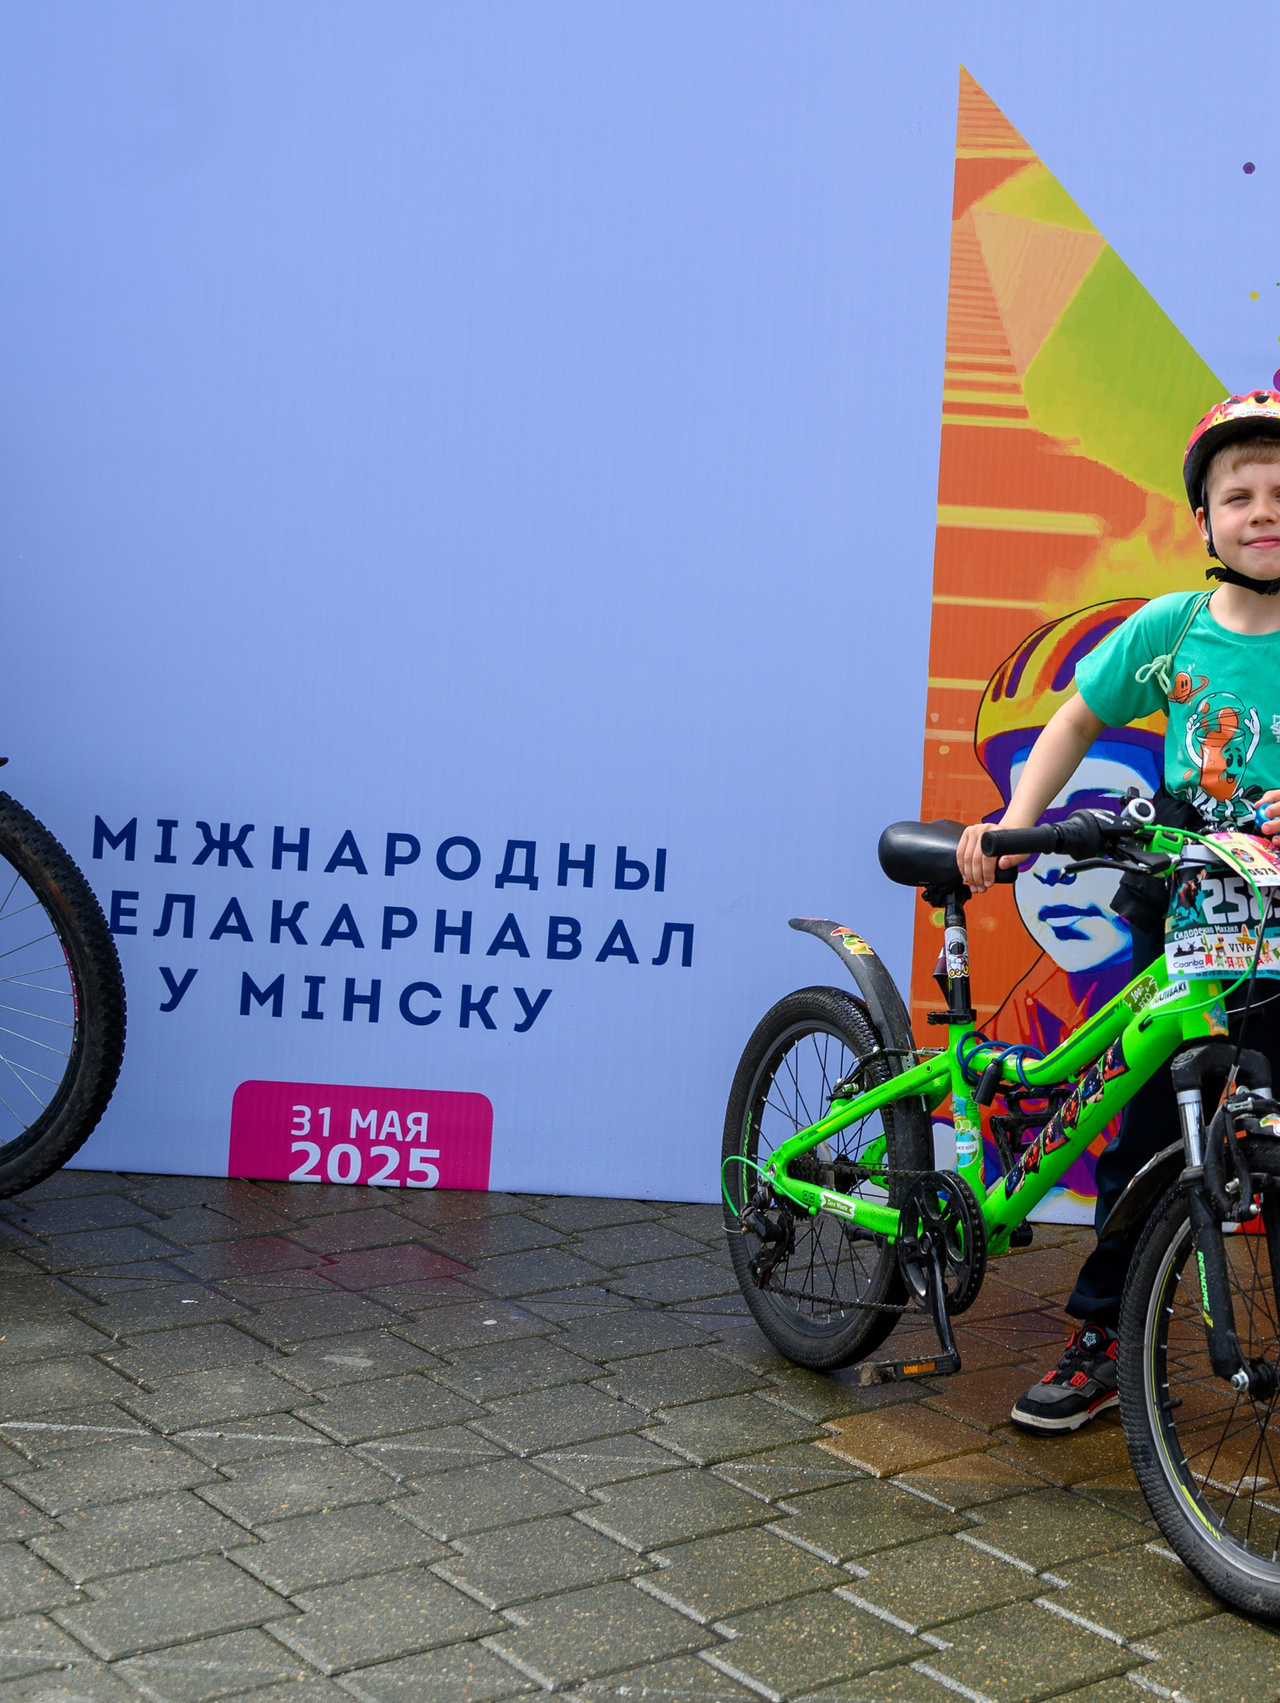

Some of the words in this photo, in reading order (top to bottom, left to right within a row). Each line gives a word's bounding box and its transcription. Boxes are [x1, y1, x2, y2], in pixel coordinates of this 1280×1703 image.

[92, 815, 667, 892] МІЖНАРОДНЫ
[1241, 867, 1277, 876] 0679
[110, 890, 695, 968] ЕЛАКАРНАВАЛ
[1228, 943, 1254, 953] VIVA
[159, 966, 198, 1013] У
[239, 971, 553, 1033] МІНСКУ
[291, 1105, 331, 1138] 31
[350, 1109, 429, 1143] МАЯ
[288, 1141, 440, 1189] 2025
